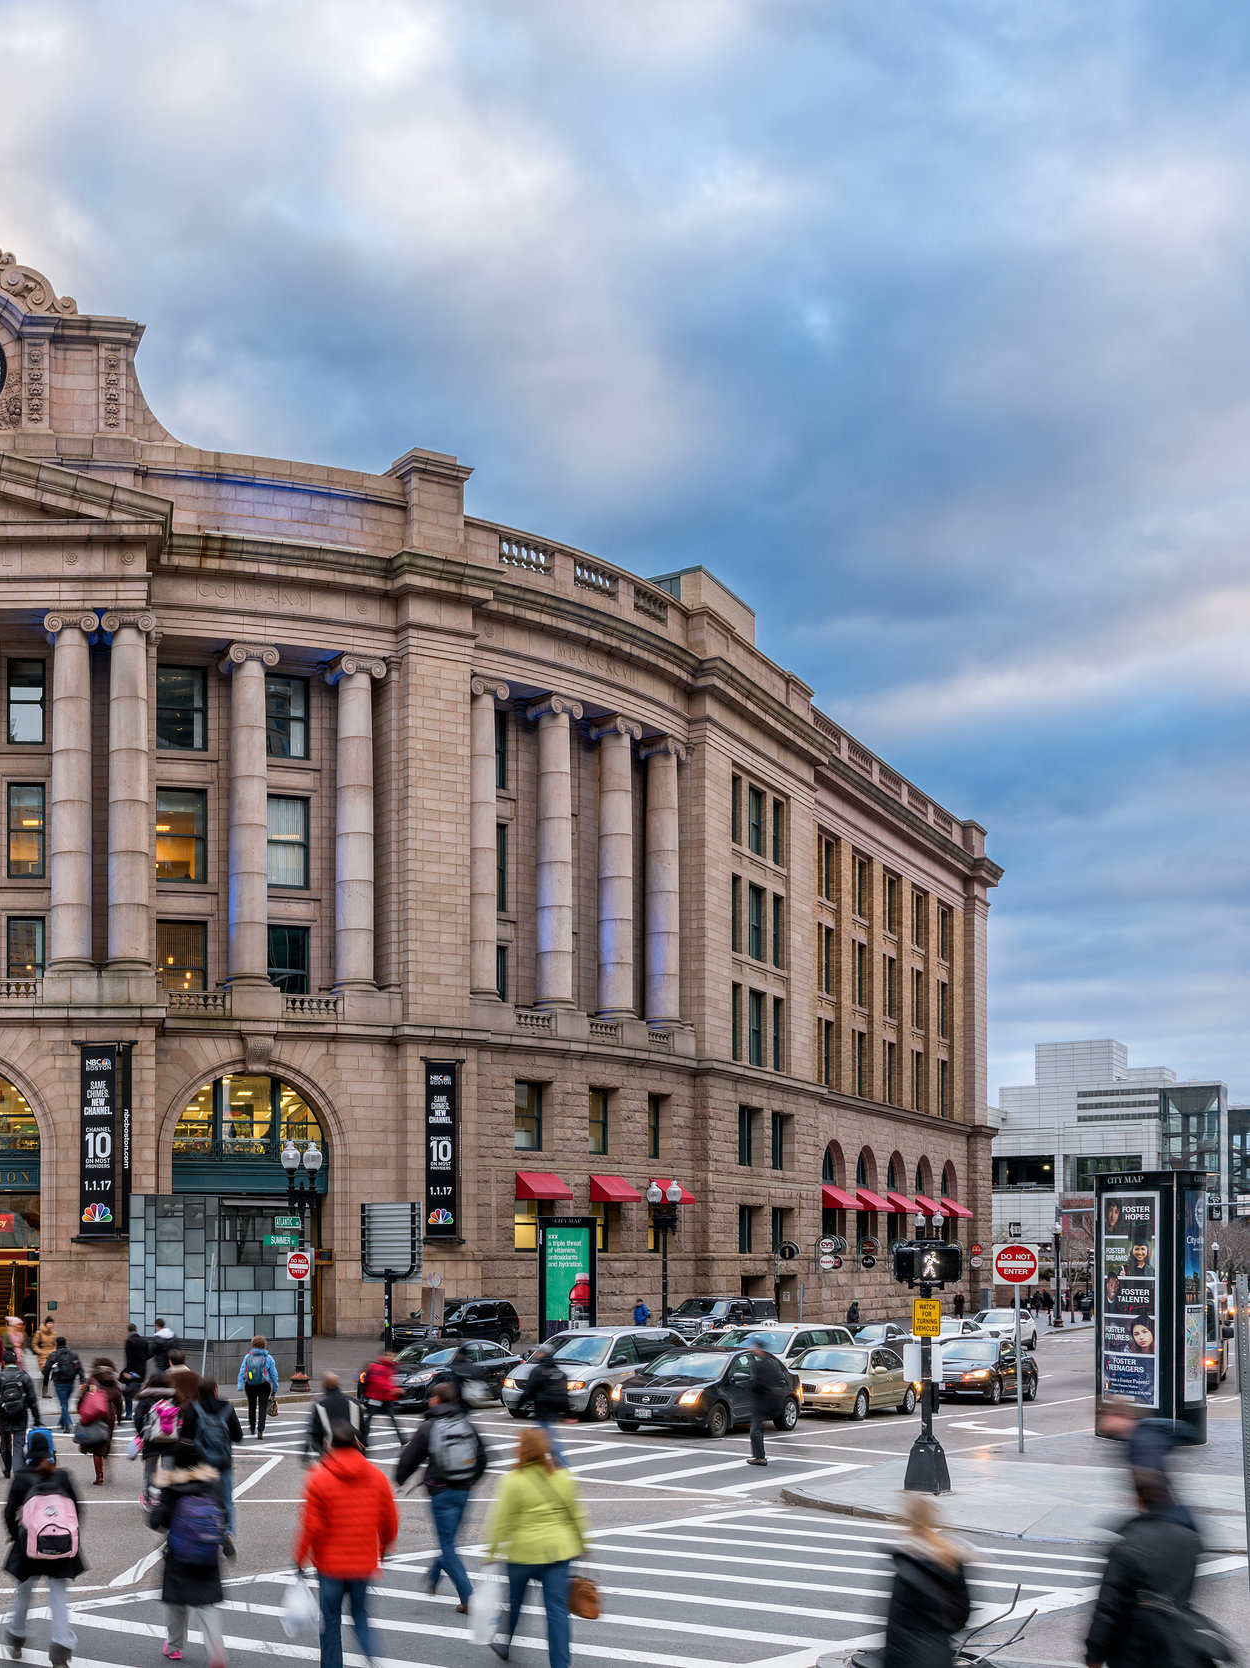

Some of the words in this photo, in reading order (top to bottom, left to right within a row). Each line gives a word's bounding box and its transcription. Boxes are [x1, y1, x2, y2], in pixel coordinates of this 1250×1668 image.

[199, 583, 310, 606] COMPANY
[557, 641, 636, 683] MDCCCXCVII
[90, 1081, 106, 1089] SAME
[86, 1089, 109, 1098] CHIMES.
[91, 1098, 105, 1106] NEW
[84, 1106, 112, 1115] CHANNEL.
[85, 1132, 111, 1158] 10
[430, 1140, 451, 1161] 10
[1107, 1176, 1123, 1184] CITY
[1124, 1175, 1144, 1183] MAP
[84, 1180, 111, 1190] 1.1.17
[430, 1187, 452, 1195] 1.1.17
[276, 1217, 293, 1226] ATLANTIC
[270, 1236, 291, 1244] SUMMER
[784, 1248, 789, 1258] 1
[1121, 1288, 1150, 1296] FOSTER
[1105, 1333, 1130, 1341] FUTURES
[1113, 1357, 1136, 1365] FOSTER
[1108, 1364, 1144, 1373] TEENAGERS
